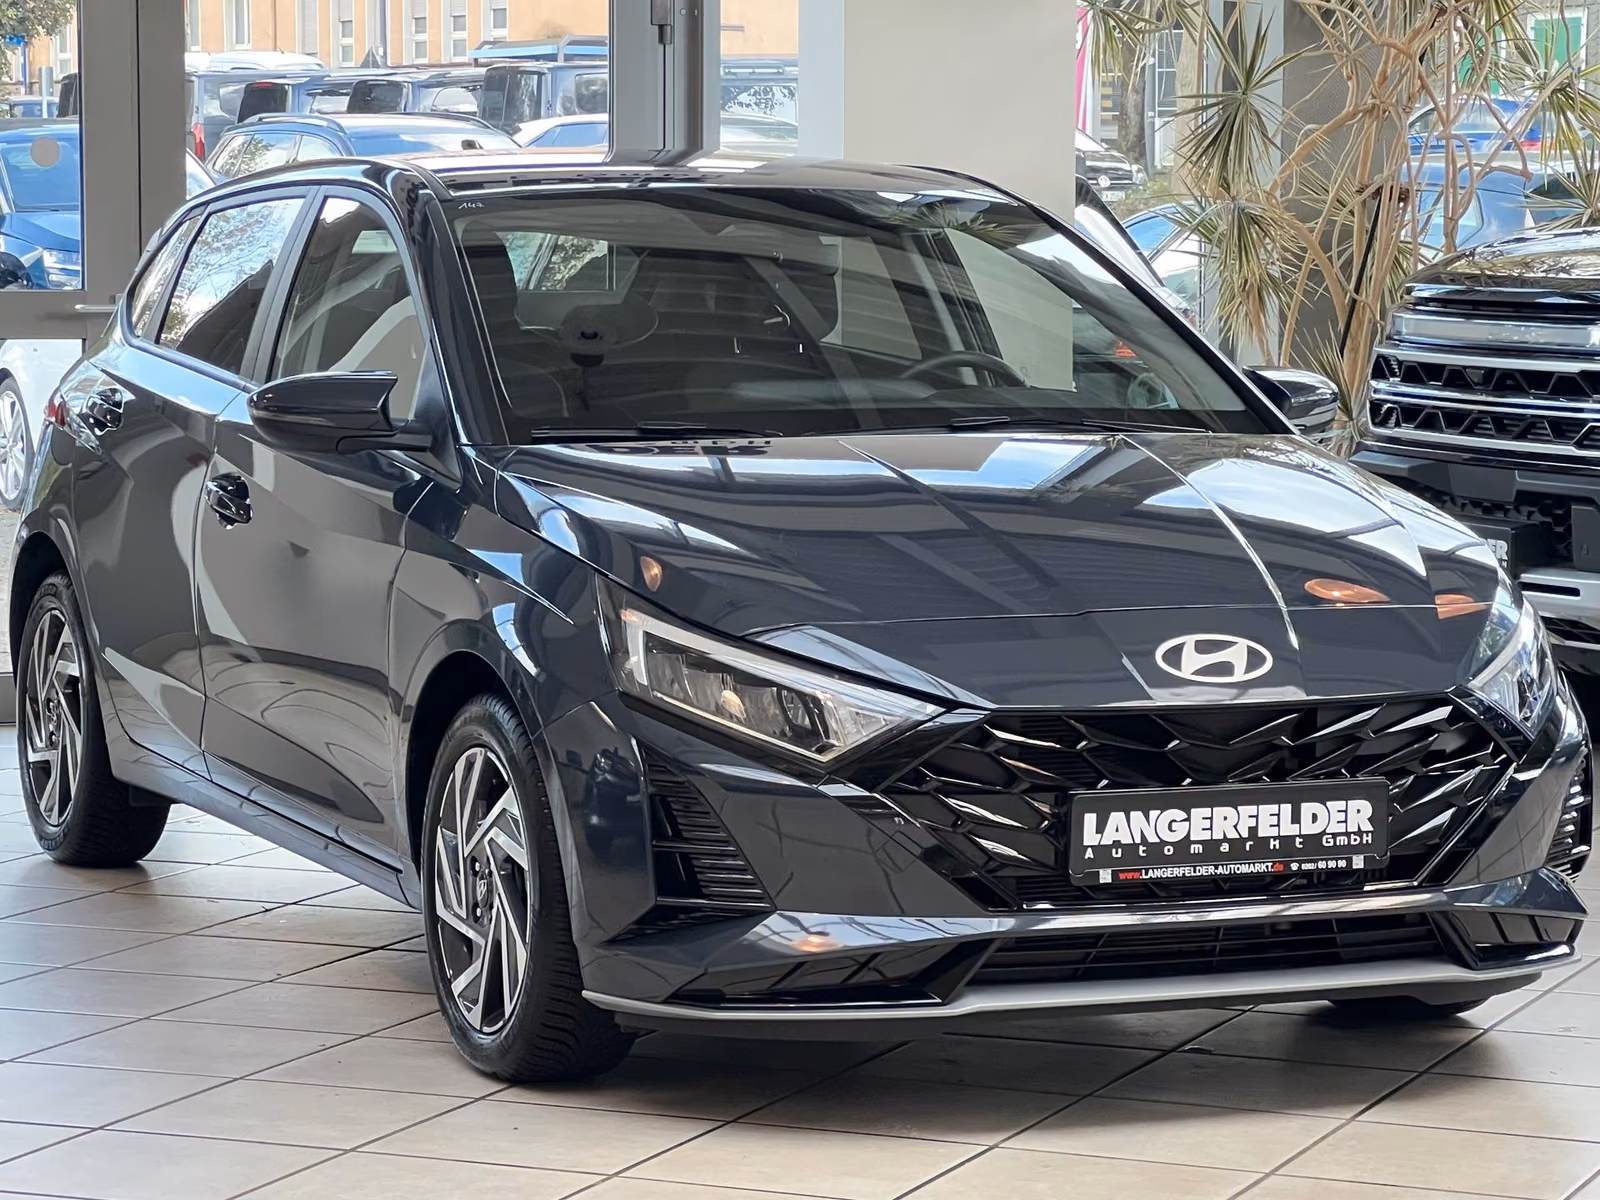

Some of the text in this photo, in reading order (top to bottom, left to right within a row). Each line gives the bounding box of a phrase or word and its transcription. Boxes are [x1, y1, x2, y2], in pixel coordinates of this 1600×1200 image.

[1083, 799, 1374, 846] LANGERFELDER
[1322, 832, 1372, 847] GmbH
[1118, 862, 1284, 879] www.LANGERFELDER-AUTOMARKT.de
